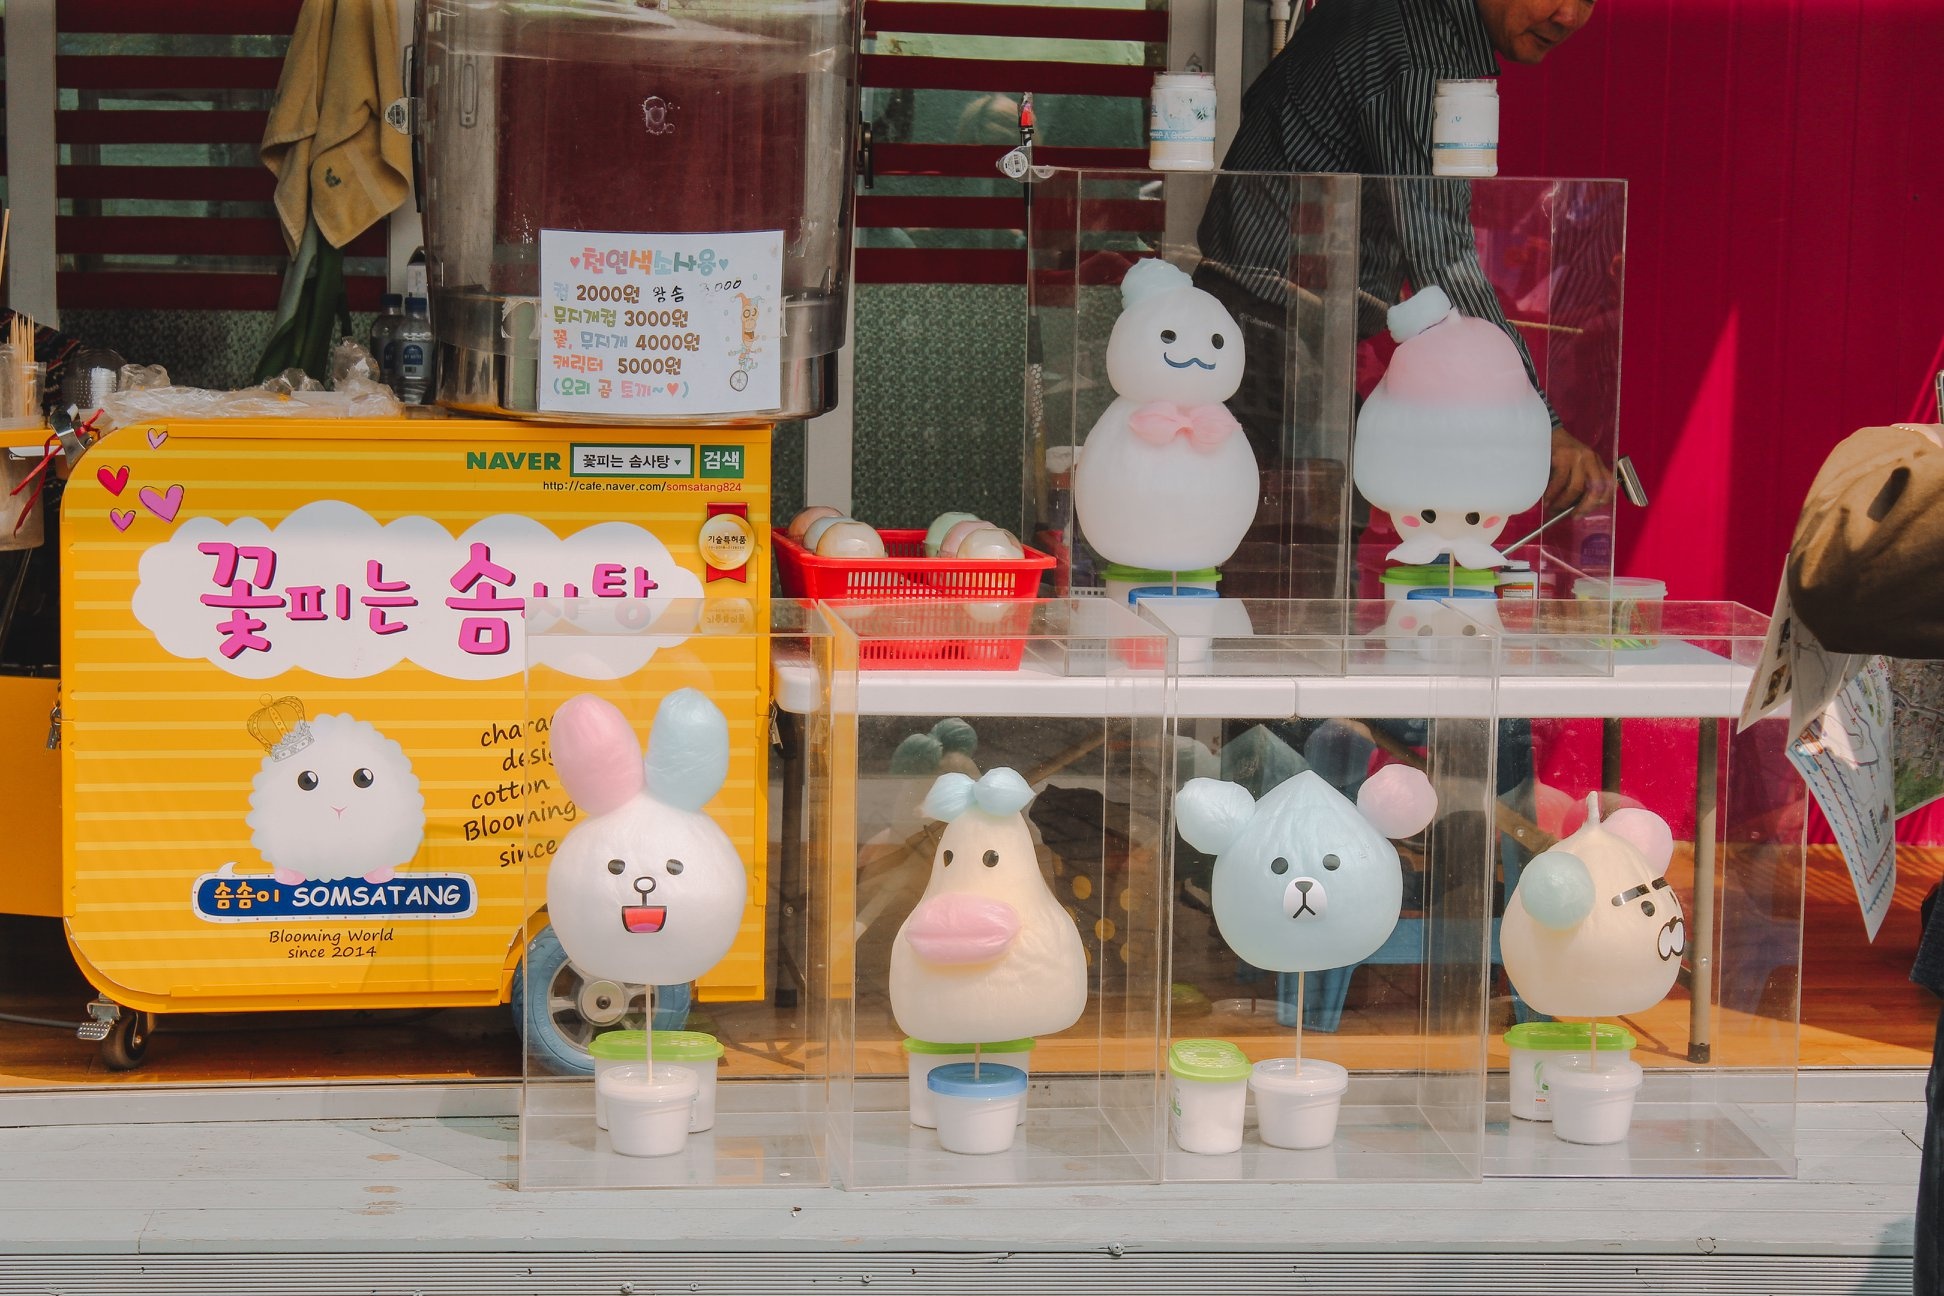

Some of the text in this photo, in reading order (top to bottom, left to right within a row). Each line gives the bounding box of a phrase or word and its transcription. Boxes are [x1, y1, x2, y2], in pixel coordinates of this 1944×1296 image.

[582, 247, 716, 276] 천연색소사용
[577, 284, 640, 304] 2000원
[554, 305, 688, 328] 무지개컵 3000원
[581, 331, 628, 349] 무지개
[635, 332, 700, 351] 4000원
[553, 354, 681, 375] 캐릭터 5000원
[598, 379, 612, 398] 곰
[466, 450, 740, 470] NAVER 꽃피는 솜사탕 검색
[543, 480, 742, 493] http://cafe.naver.com/somsatang824
[198, 542, 418, 658] 꽃피는
[292, 885, 461, 908] SOMSATANG
[269, 927, 394, 945] Blooming World
[288, 945, 377, 959] since 2014
